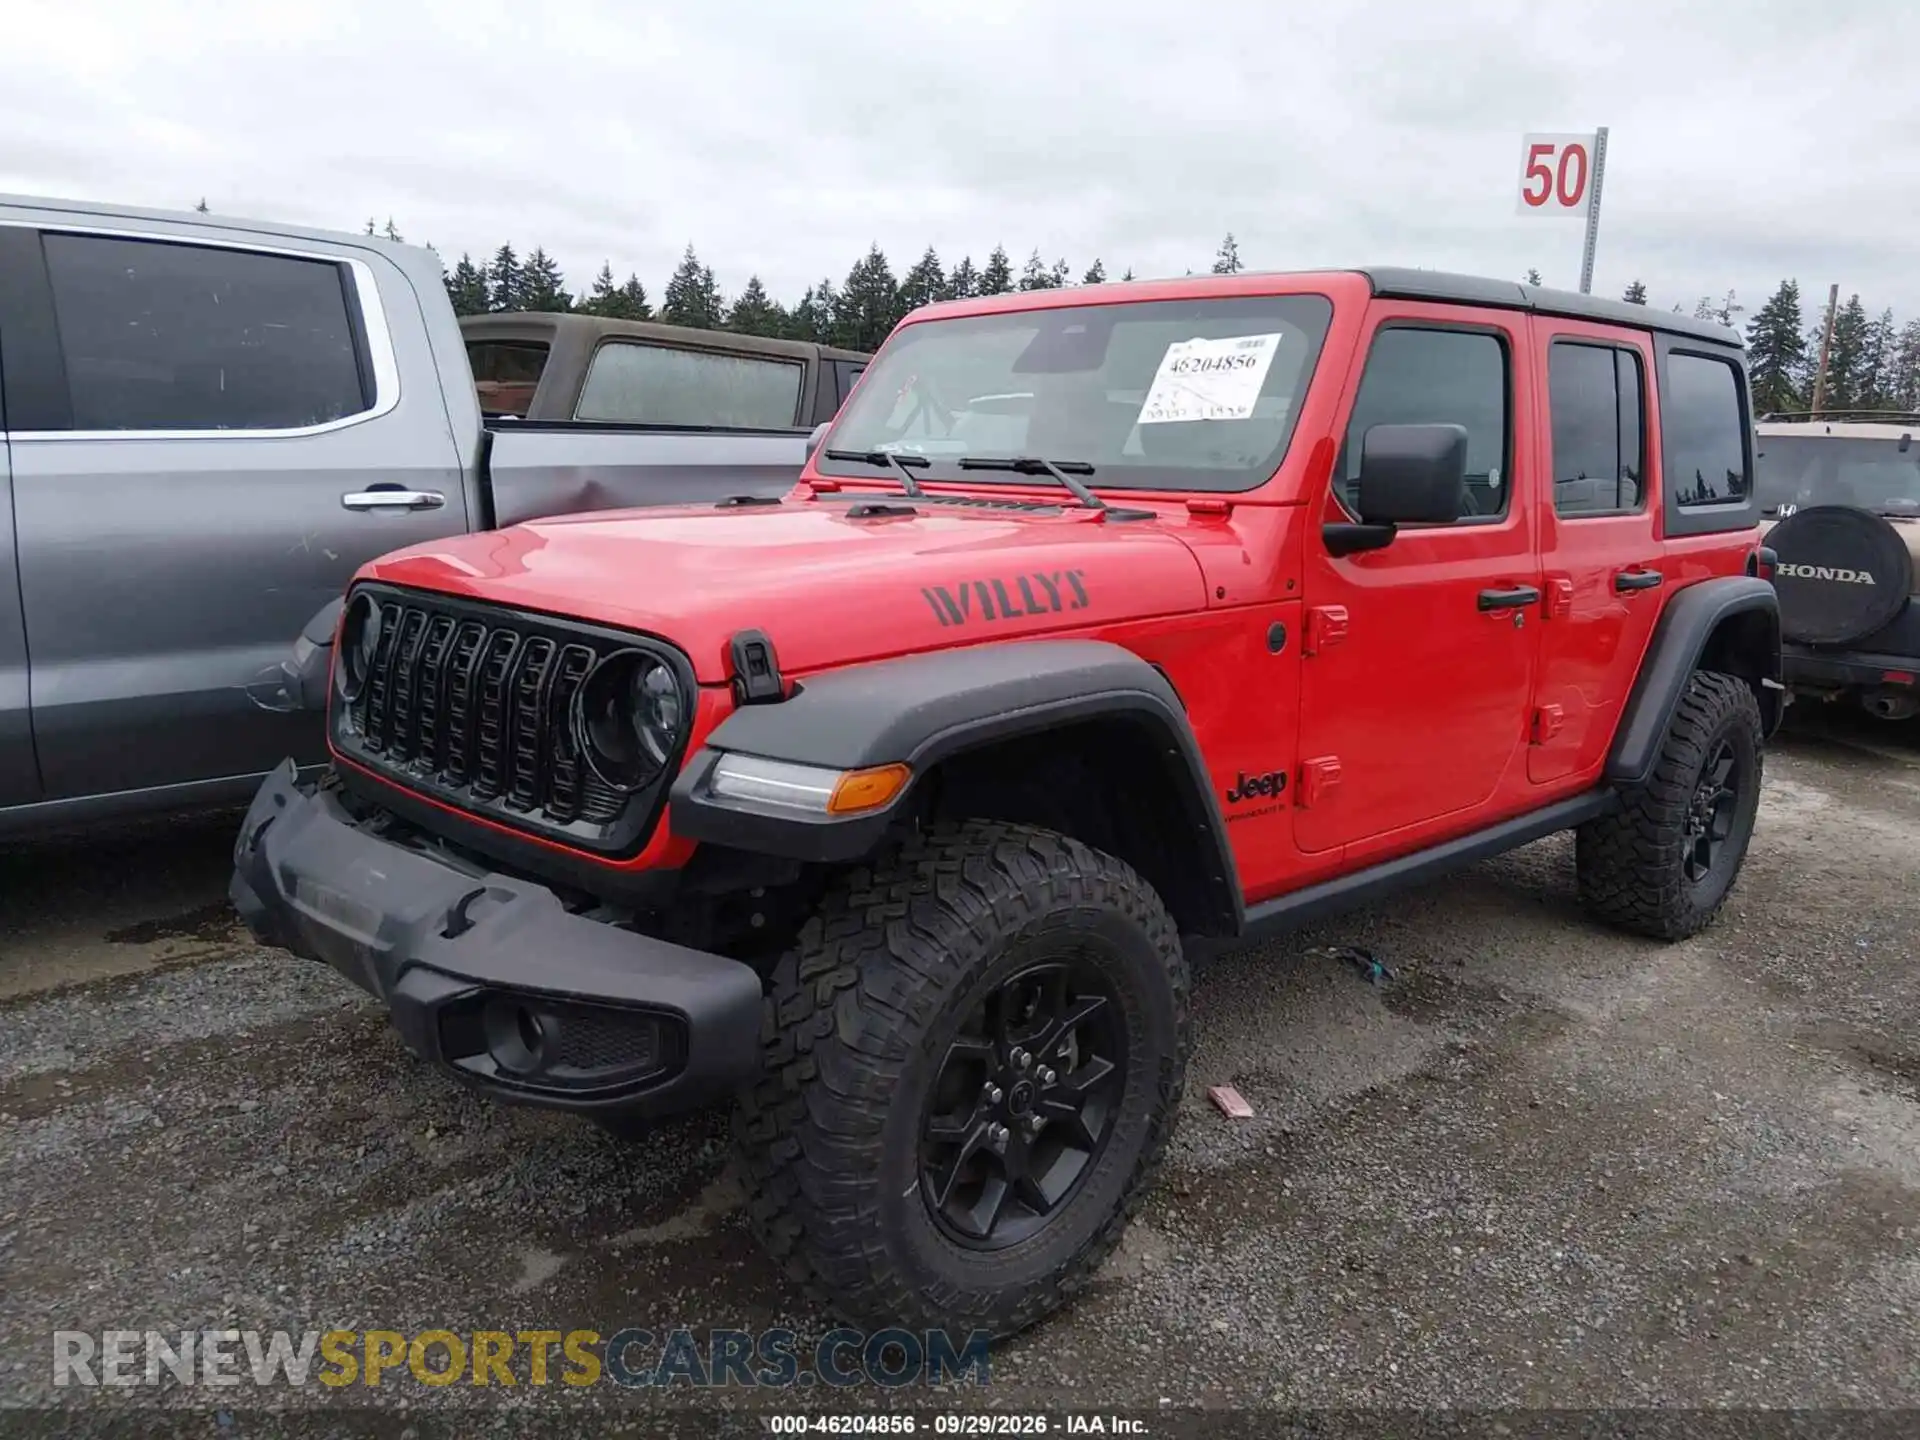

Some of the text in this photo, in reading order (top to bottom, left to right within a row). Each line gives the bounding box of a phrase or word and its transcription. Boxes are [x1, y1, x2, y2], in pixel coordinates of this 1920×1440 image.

[1523, 143, 1587, 207] 50
[1170, 353, 1257, 373] 46204856
[1776, 563, 1876, 585] HONDA
[921, 569, 1089, 627] WILLYS
[1226, 771, 1288, 804] Jeep
